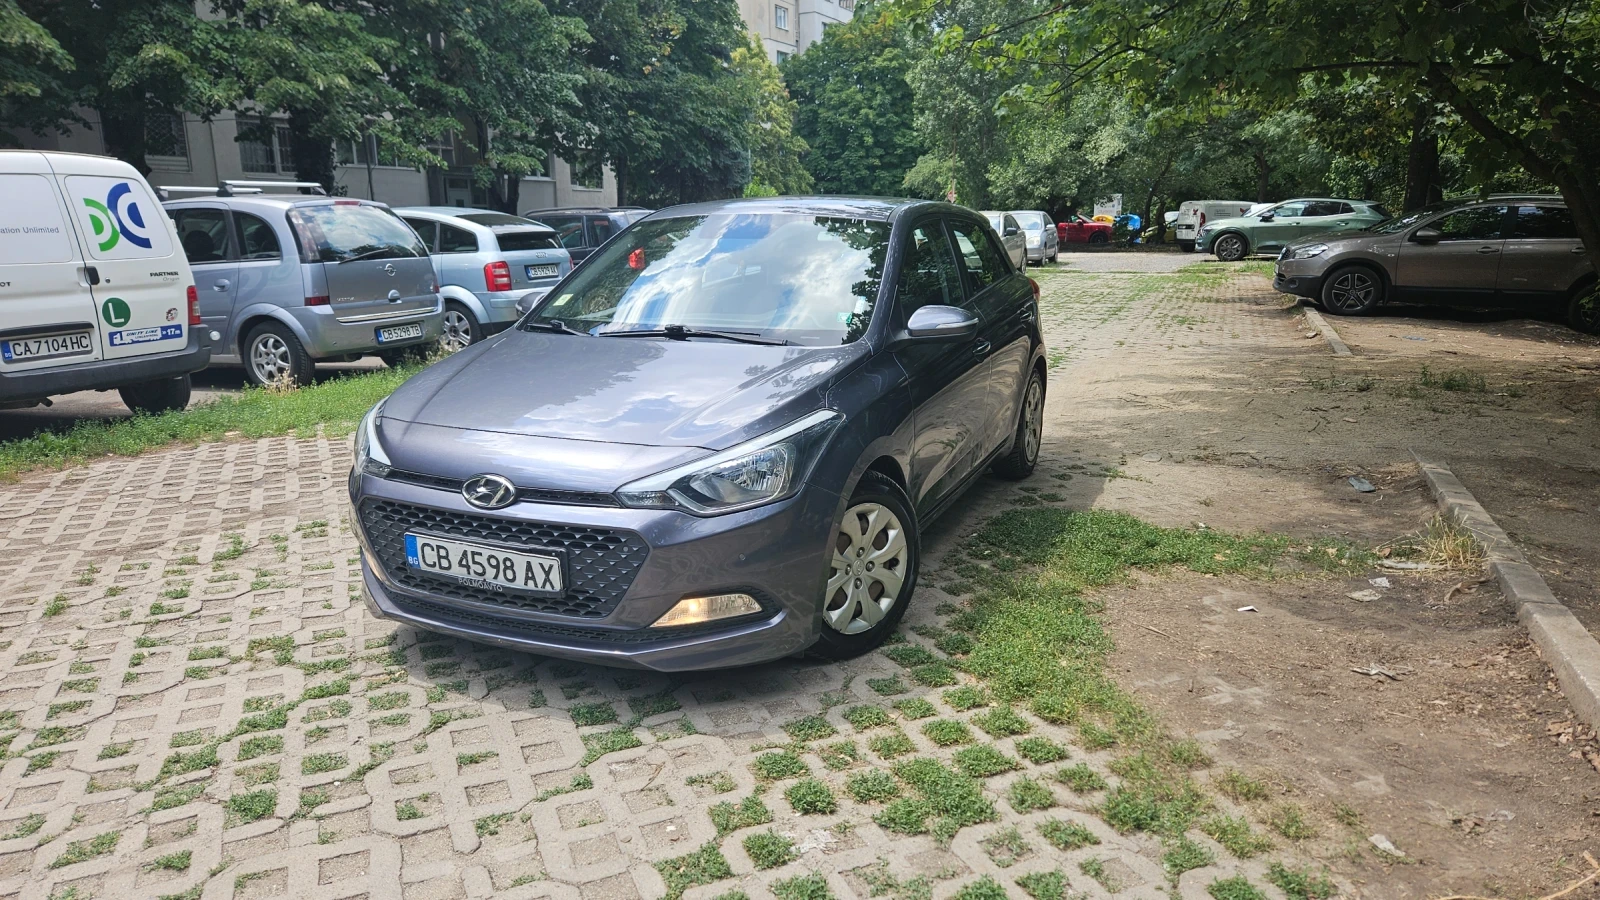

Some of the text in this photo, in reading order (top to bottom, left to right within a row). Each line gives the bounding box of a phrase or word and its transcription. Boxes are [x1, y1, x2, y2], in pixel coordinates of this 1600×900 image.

[22, 226, 60, 234] Unlimited
[108, 302, 125, 324] L
[382, 330, 393, 340] CB
[394, 327, 410, 338] 5298
[411, 325, 420, 335] TB
[12, 335, 89, 356] CA 7104 HC
[408, 555, 419, 565] BG
[420, 542, 556, 590] CB 4598 AX
